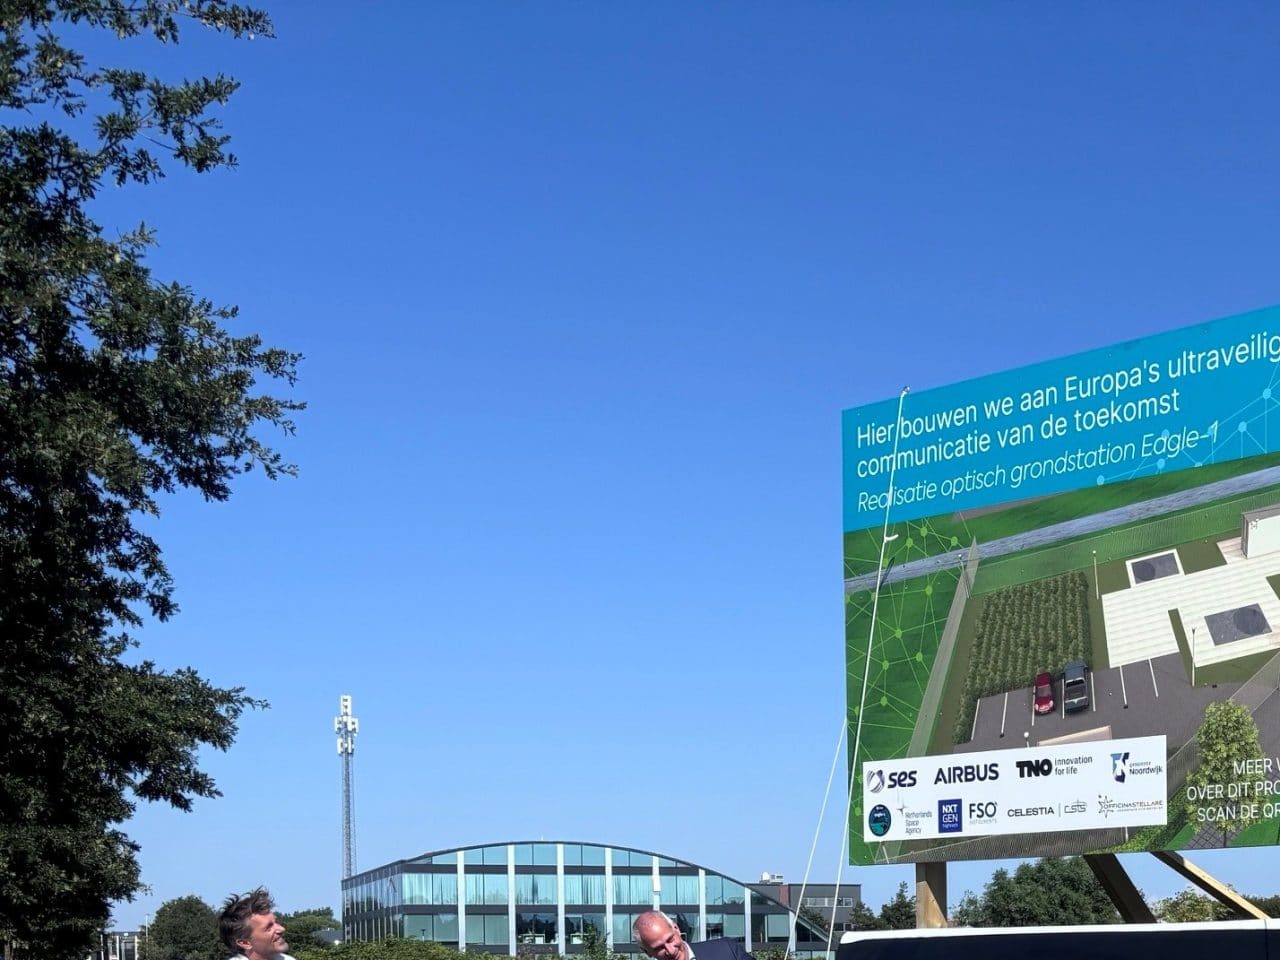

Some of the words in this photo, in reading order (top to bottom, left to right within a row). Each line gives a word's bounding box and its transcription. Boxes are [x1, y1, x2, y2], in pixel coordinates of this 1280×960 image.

[858, 422, 895, 449] Hier
[900, 404, 977, 439] bouwen
[984, 396, 1014, 420] we
[1020, 386, 1058, 412] aan
[1065, 360, 1160, 402] Europa's
[857, 430, 991, 478] communicatie
[997, 424, 1034, 448] van
[1041, 414, 1067, 439] de
[1074, 388, 1180, 433] toekomst
[858, 480, 937, 512] Realisatie
[941, 465, 1006, 499] optisch
[1011, 442, 1136, 488] grondstation
[1016, 758, 1053, 778] TNO
[1055, 755, 1093, 766] innovation
[1233, 758, 1272, 775] MEER
[934, 763, 999, 785] AIRBUS
[1055, 767, 1065, 776] for
[1066, 766, 1078, 775] life
[1129, 765, 1163, 776] Noordwijk
[1187, 784, 1224, 801] OVER
[1228, 782, 1250, 798] DIT
[942, 804, 958, 813] NXT
[969, 801, 997, 819] FSO
[1007, 806, 1054, 818] CELESTIA
[1197, 806, 1236, 822] SCAN
[1240, 804, 1259, 820] DE
[942, 814, 958, 823] GEN
